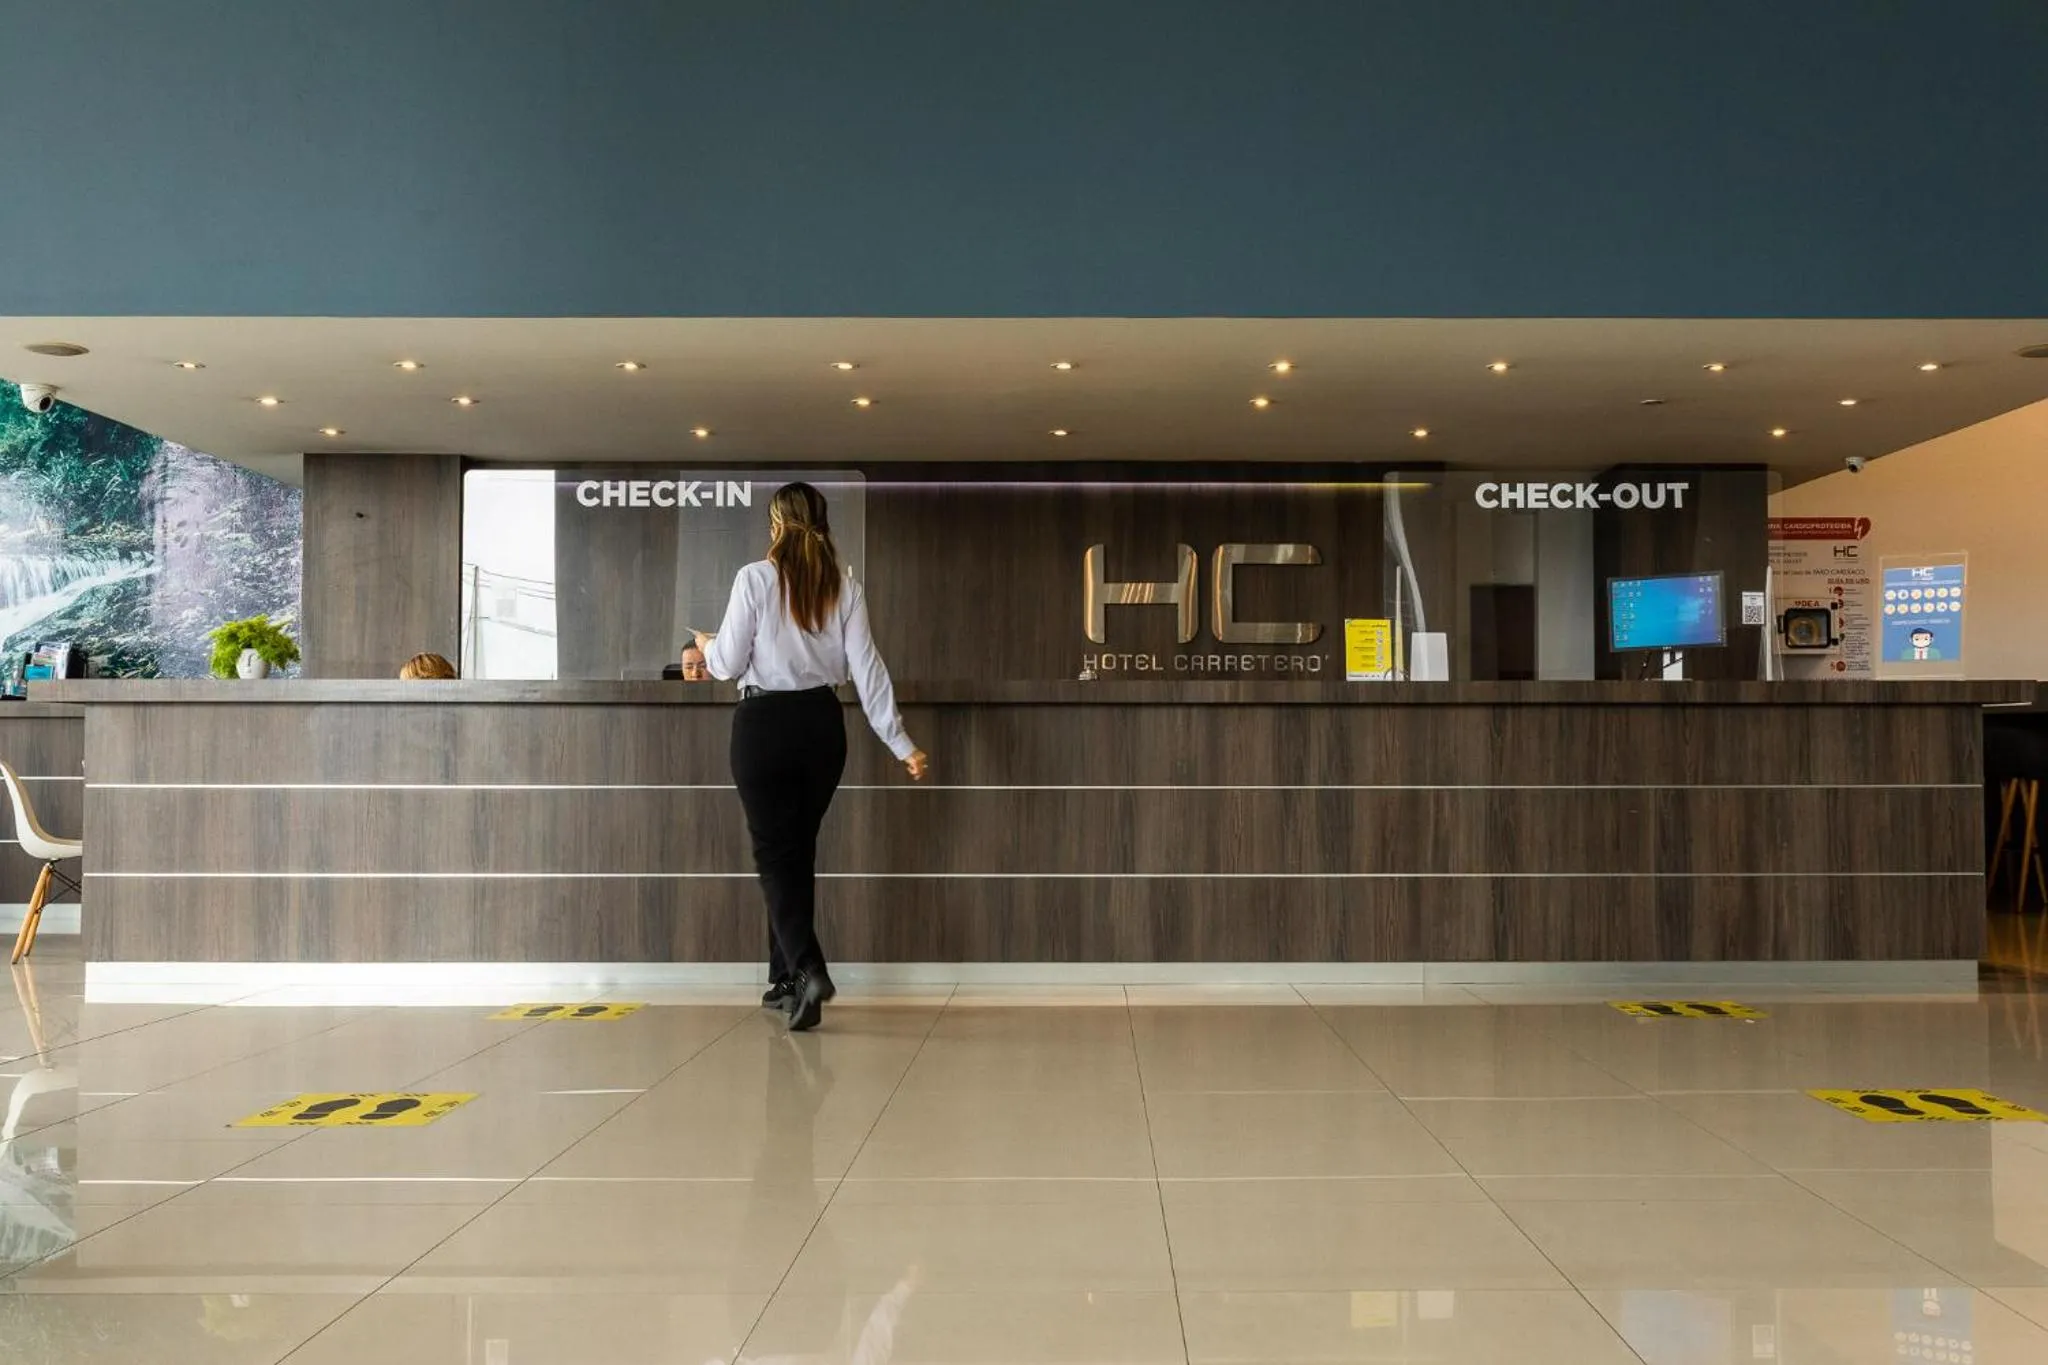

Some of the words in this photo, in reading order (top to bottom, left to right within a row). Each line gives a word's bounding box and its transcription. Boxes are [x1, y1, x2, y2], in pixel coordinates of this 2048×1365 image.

[576, 480, 752, 507] CHECK-IN
[1475, 482, 1689, 509] CHECK-OUT
[1833, 545, 1858, 557] HC
[1911, 567, 1935, 577] HC
[1083, 543, 1322, 644] HC
[1083, 653, 1165, 672] HOTEL
